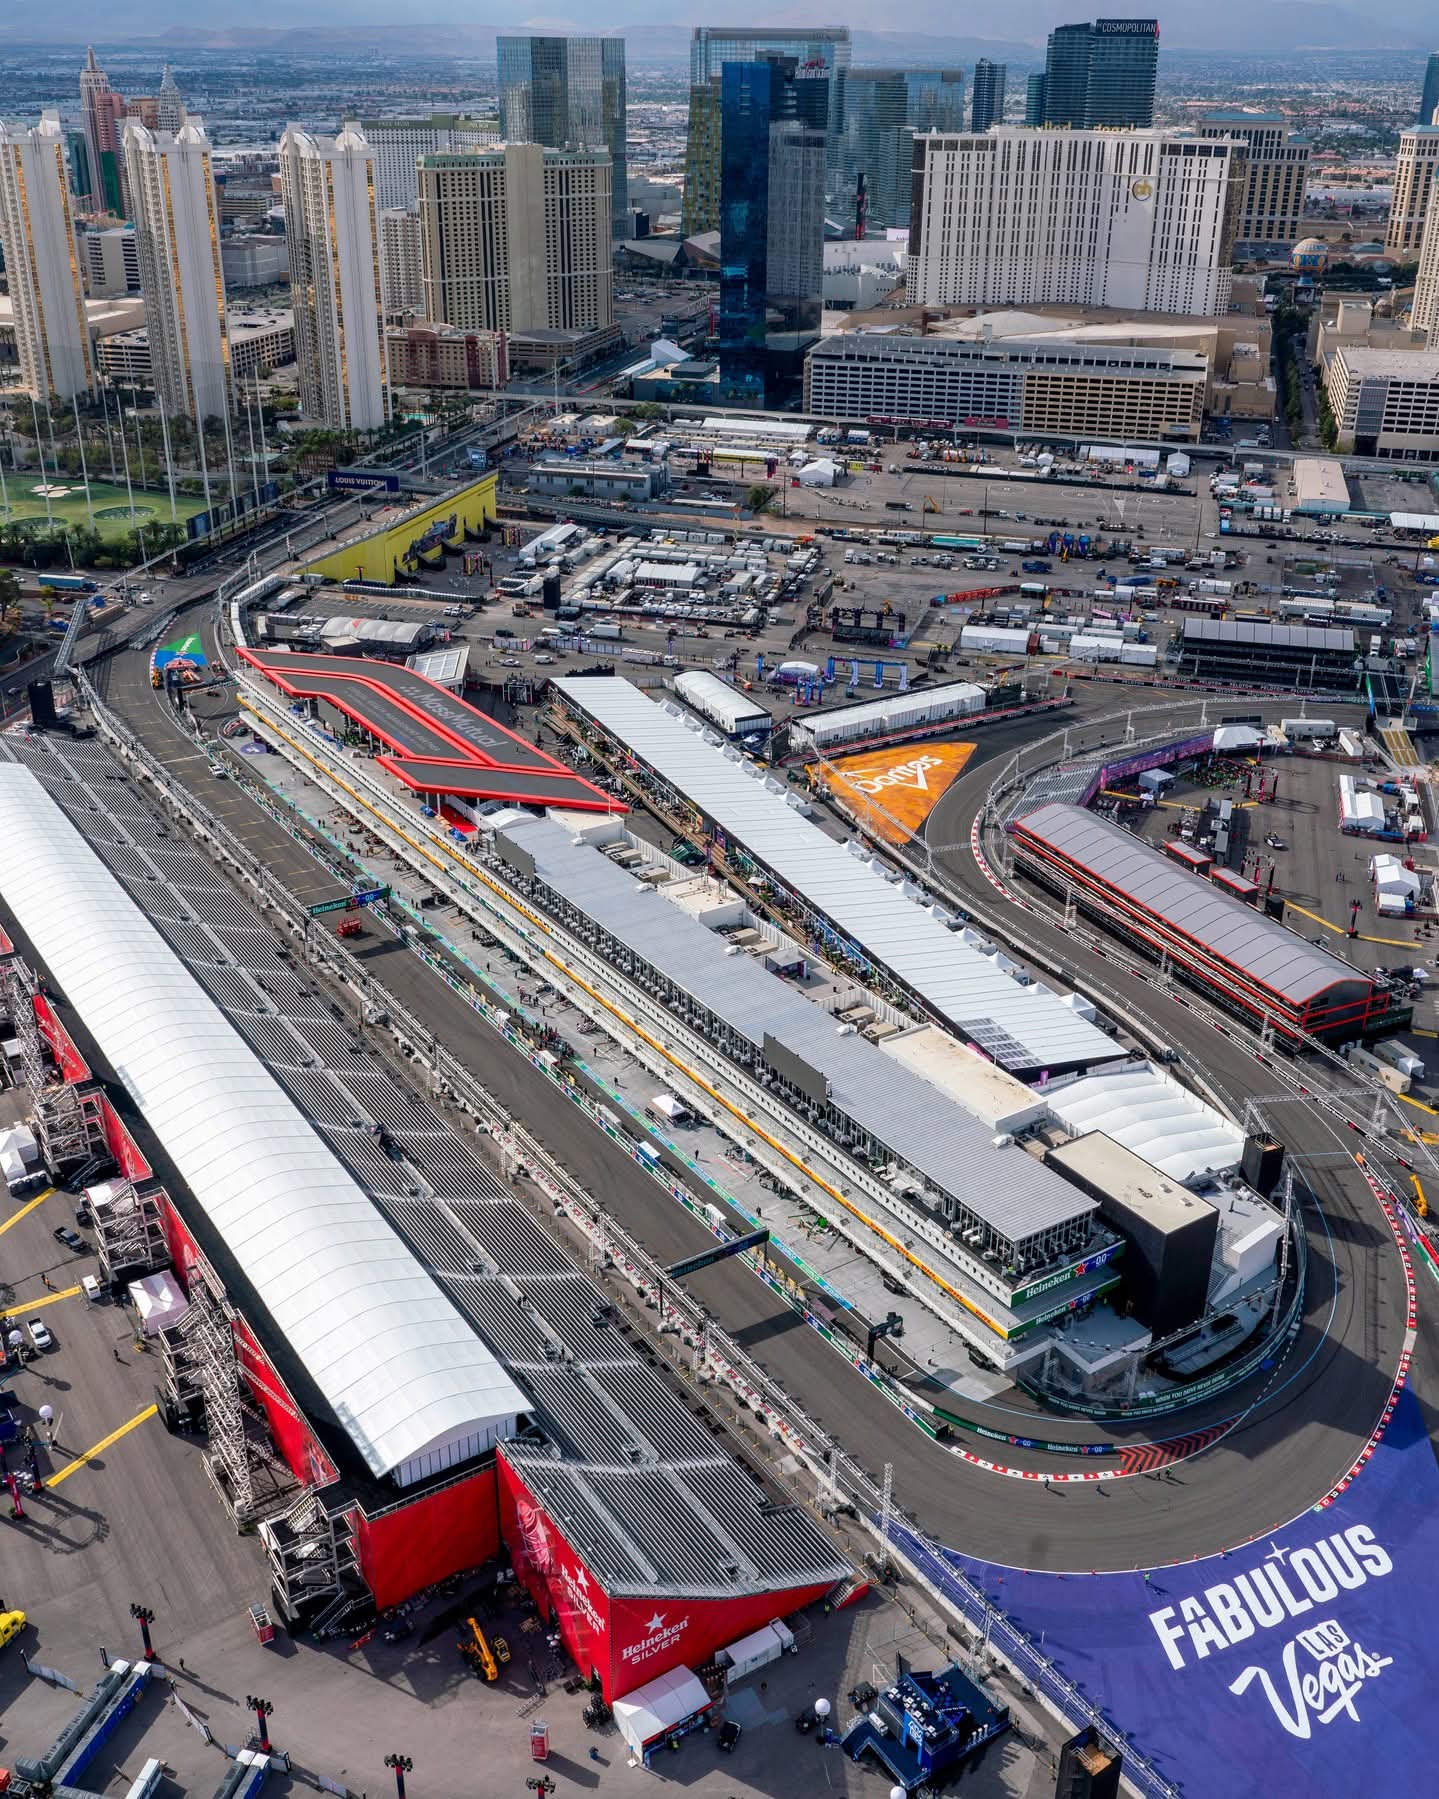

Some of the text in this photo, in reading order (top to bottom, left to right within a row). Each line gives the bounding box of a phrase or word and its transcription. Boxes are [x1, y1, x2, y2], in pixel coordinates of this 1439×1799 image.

[1102, 22, 1156, 33] COSMOPOLITAN
[336, 476, 355, 484] LOUIS
[414, 693, 508, 748] MassMutual
[854, 755, 943, 794] Doritos
[312, 901, 347, 914] Heineken
[1230, 1034, 1257, 1056] Openbank
[1272, 1065, 1300, 1088] Openbank
[1317, 1099, 1348, 1123] Openbank
[1365, 1134, 1398, 1160] Openbank
[1026, 1272, 1071, 1298] Heineken
[975, 1309, 991, 1323] DHL
[1035, 1307, 1066, 1325] Heineken
[977, 1427, 1006, 1440] Heineken
[1047, 1444, 1078, 1452] Heineken
[561, 1563, 606, 1632] Heineken
[1148, 1524, 1393, 1671] FABULOUS
[568, 1586, 600, 1636] SILVER
[622, 1619, 689, 1660] Heineken
[631, 1634, 681, 1665] SILVER
[1302, 1624, 1344, 1655] LAS
[1228, 1640, 1393, 1739] Vegas
